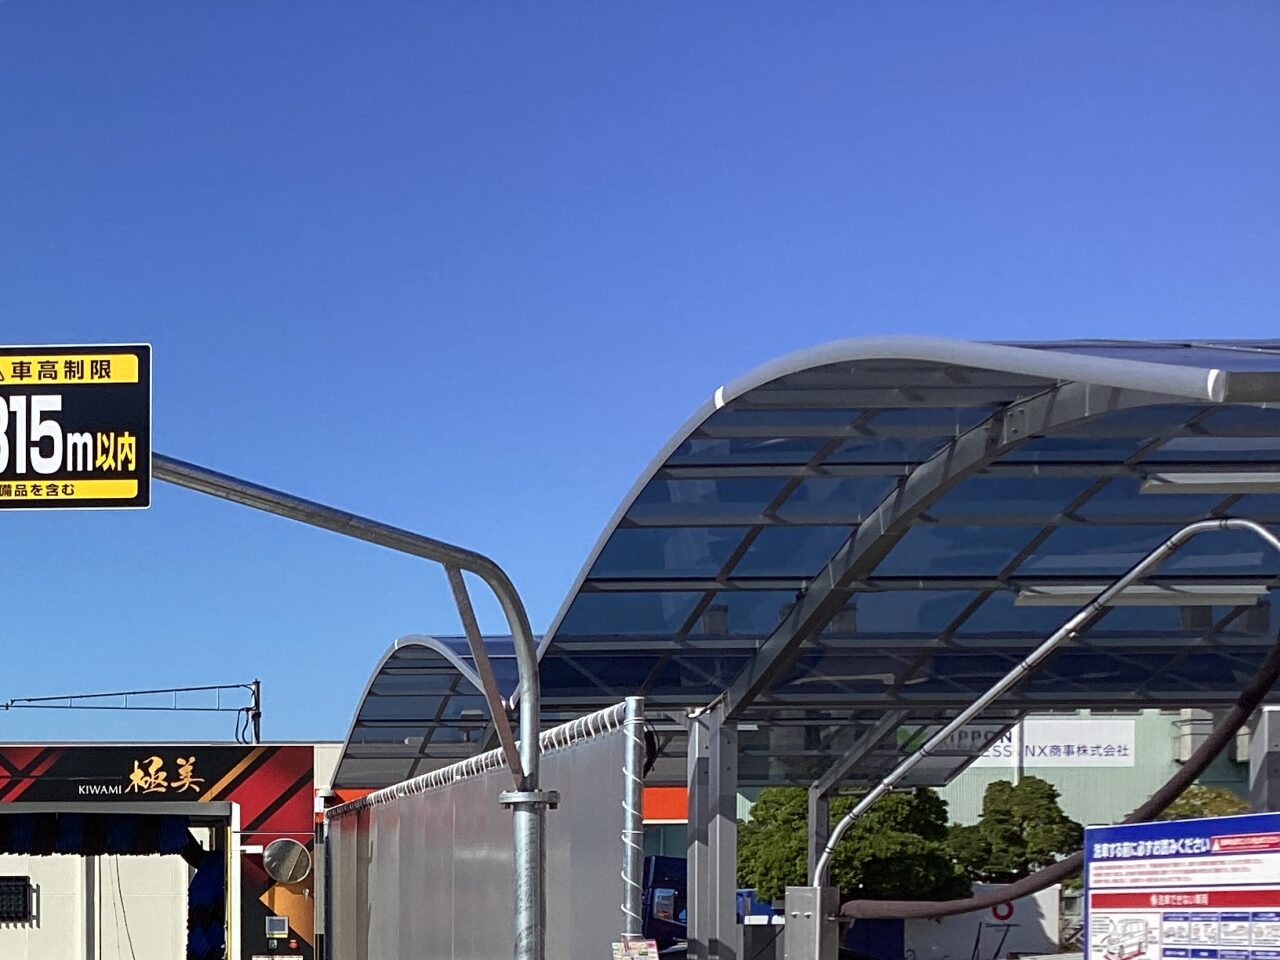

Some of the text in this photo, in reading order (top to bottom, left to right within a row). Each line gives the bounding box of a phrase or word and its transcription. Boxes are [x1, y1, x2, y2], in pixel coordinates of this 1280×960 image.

[10, 360, 111, 380] 車高制限
[1024, 744, 1129, 757] NX商事株式会社
[78, 785, 122, 794] KIWAMI
